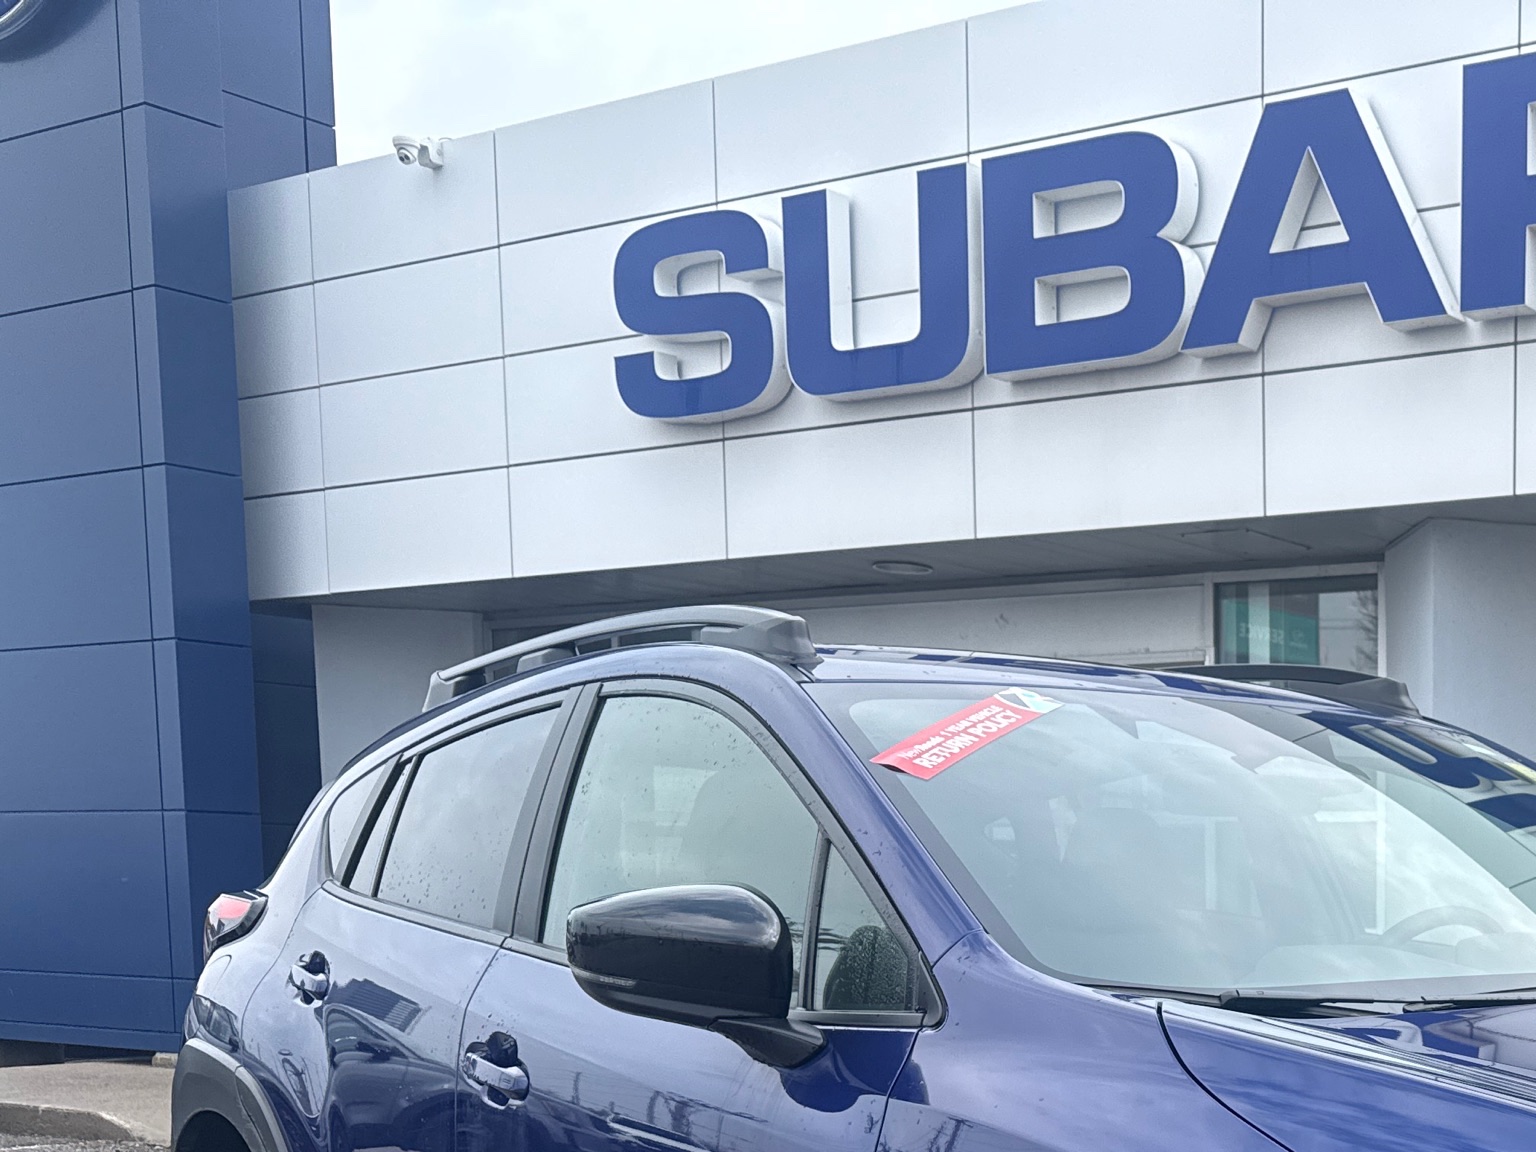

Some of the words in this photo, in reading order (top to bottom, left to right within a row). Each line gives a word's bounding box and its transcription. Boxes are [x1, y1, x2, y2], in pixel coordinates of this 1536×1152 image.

[912, 732, 980, 769] RETURN
[971, 709, 1023, 738] POLICY
[948, 717, 972, 734] YEAR
